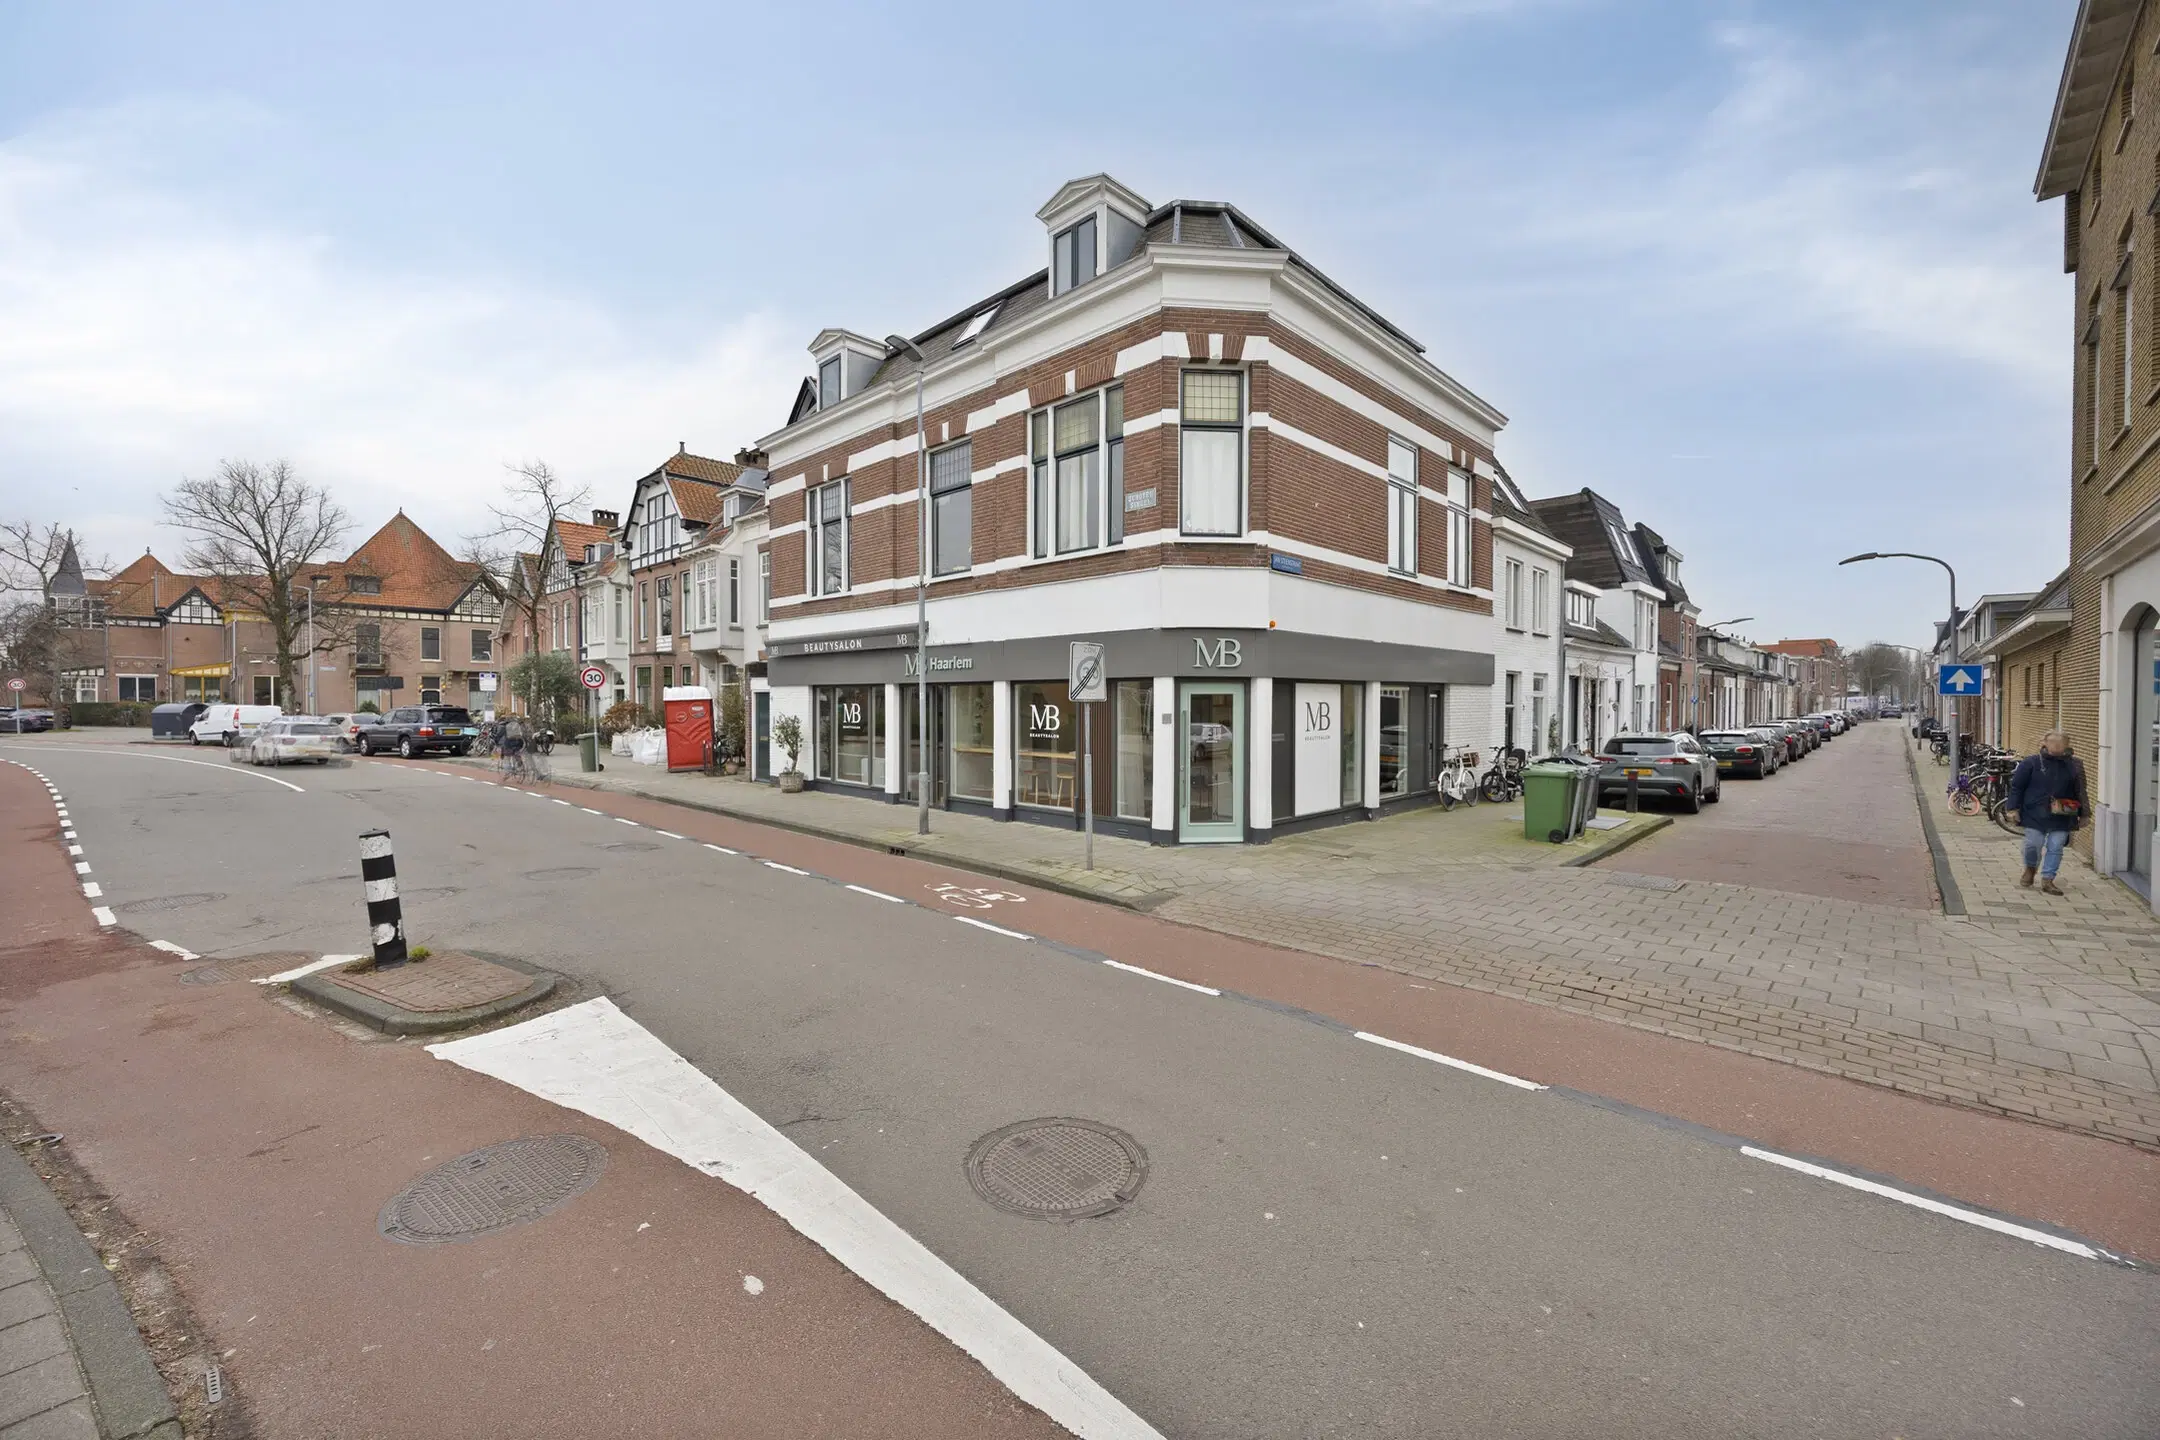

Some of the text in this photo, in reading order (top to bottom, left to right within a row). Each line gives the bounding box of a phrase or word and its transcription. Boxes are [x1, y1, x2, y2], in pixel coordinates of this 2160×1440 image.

[804, 639, 862, 652] BEAUTYSALON
[896, 634, 907, 645] MB
[1192, 637, 1242, 668] MB
[929, 656, 973, 670] Haarlem
[586, 673, 601, 683] 30
[843, 703, 861, 723] MB
[1030, 704, 1060, 730] MB
[1305, 702, 1331, 732] MB
